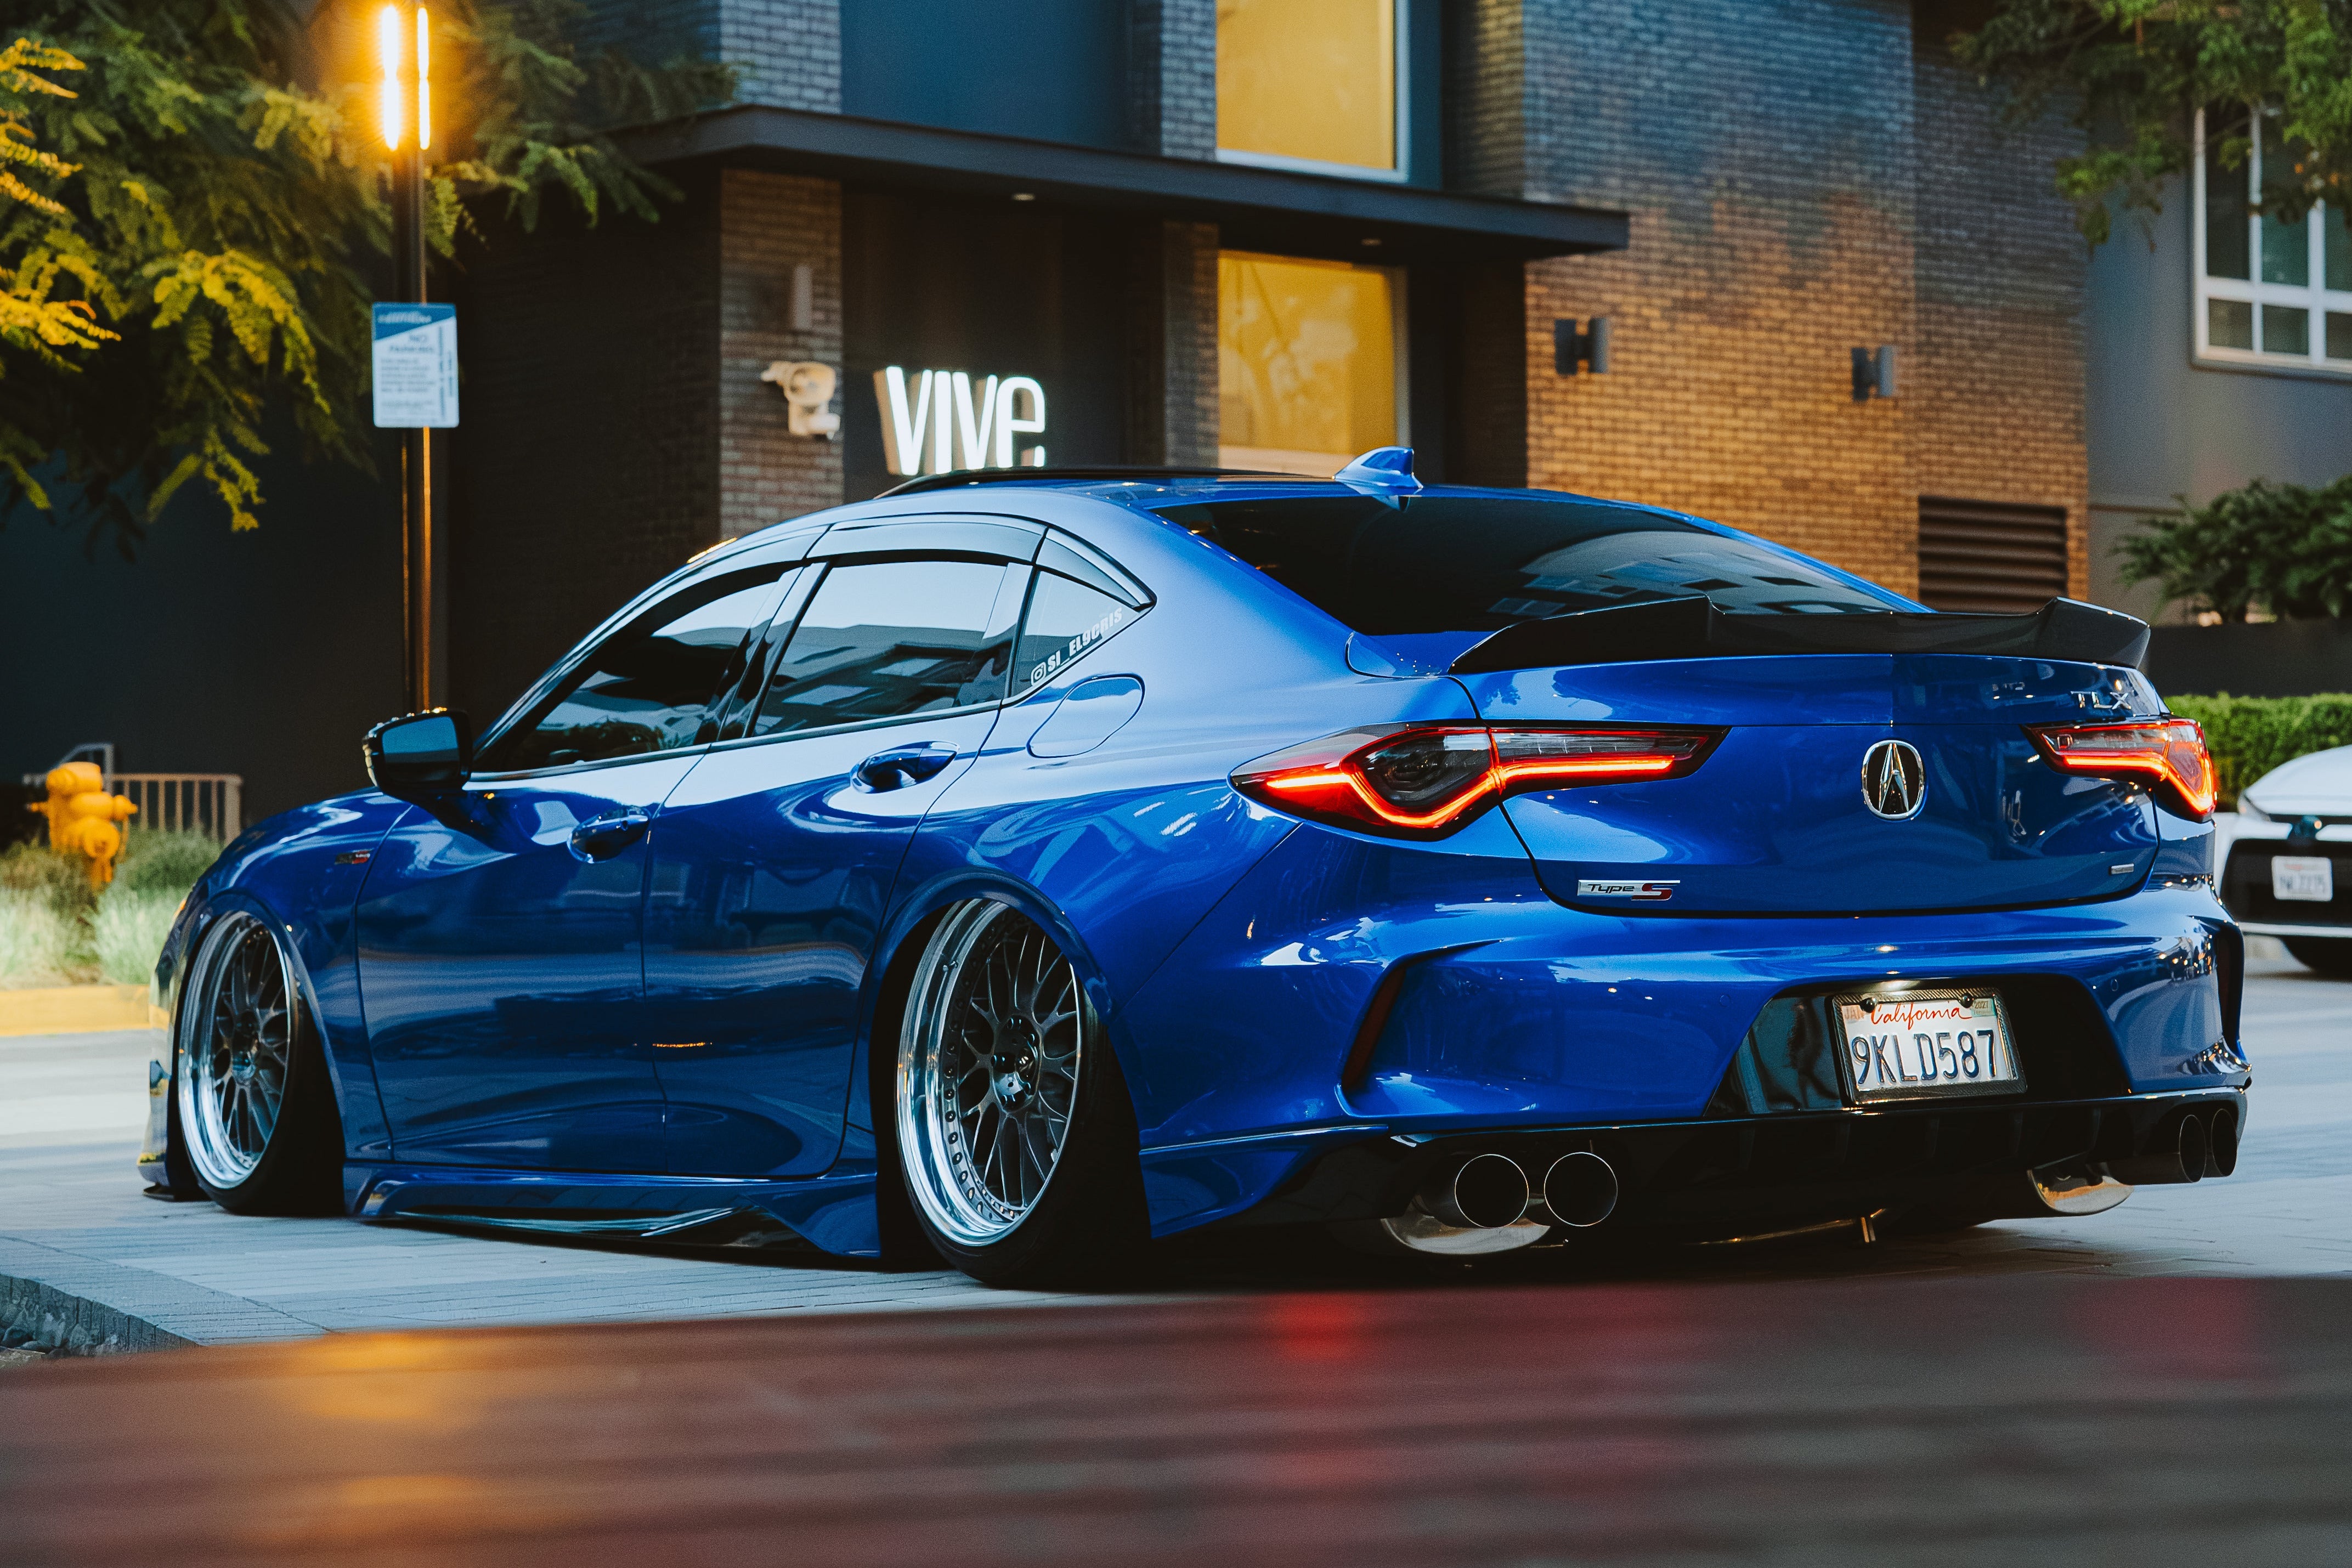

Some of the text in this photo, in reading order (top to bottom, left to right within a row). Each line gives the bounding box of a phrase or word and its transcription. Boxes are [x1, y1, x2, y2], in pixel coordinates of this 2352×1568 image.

[2071, 691, 2132, 709] TLX
[1587, 882, 1673, 901] Type S
[1870, 1001, 1973, 1030] California
[1851, 1029, 1997, 1085] 9KLD587
